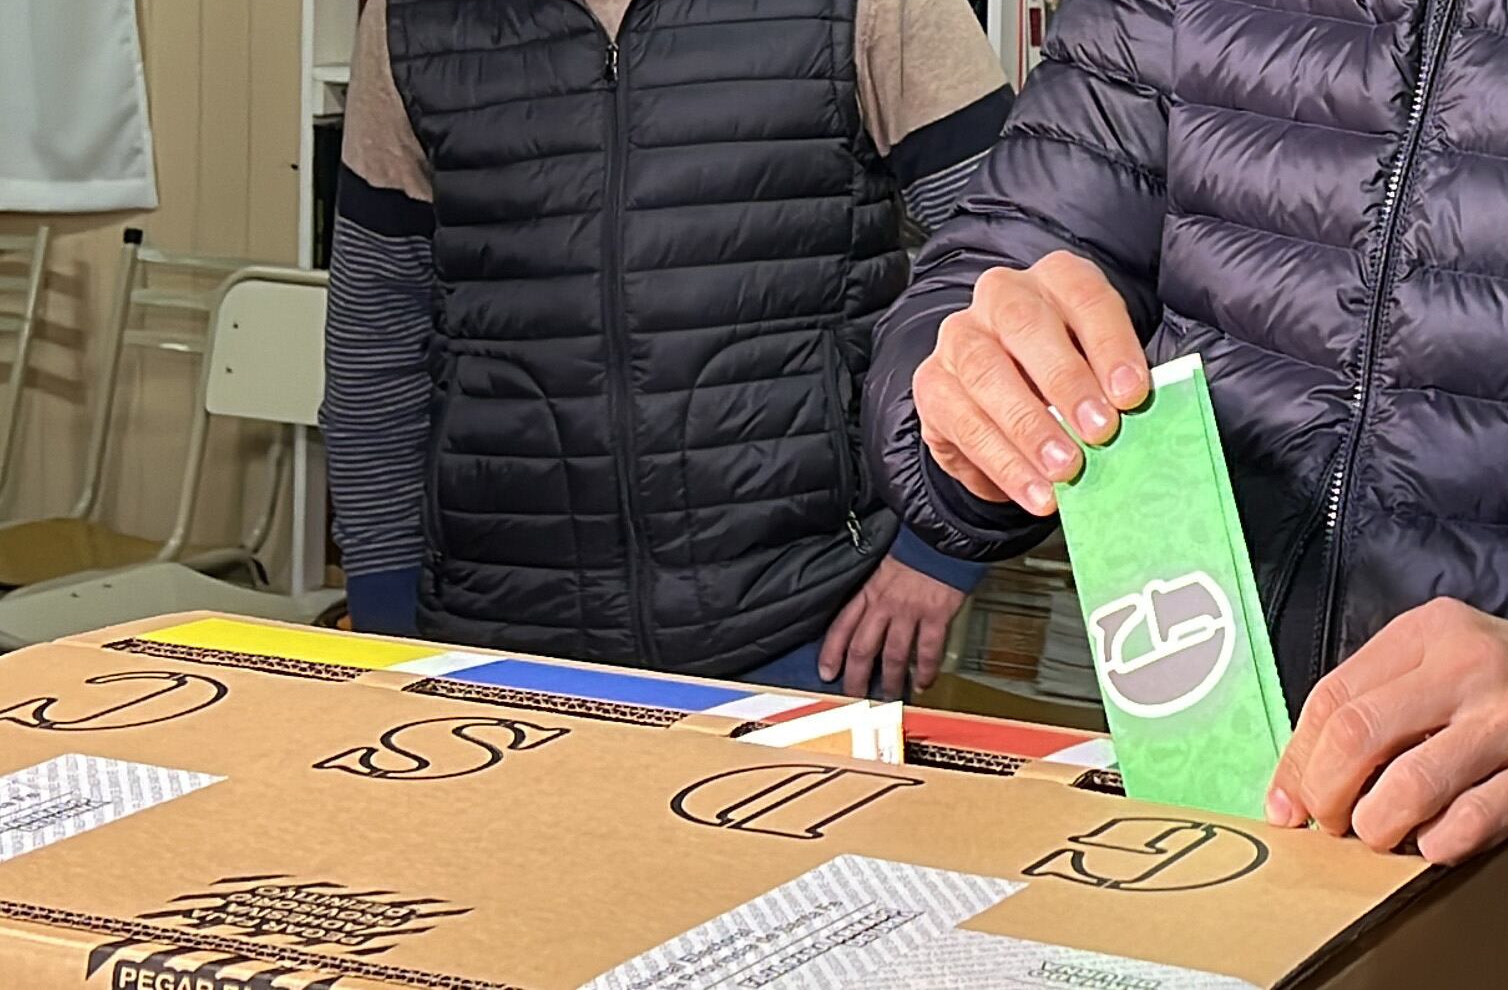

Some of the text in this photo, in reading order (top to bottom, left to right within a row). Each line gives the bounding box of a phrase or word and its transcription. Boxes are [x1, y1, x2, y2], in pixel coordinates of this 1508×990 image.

[312, 717, 571, 780] S
[670, 763, 925, 839] D
[1021, 817, 1269, 892] G
[225, 893, 403, 927] PROVISORIO
[226, 903, 367, 931] ADHESIVA
[254, 884, 411, 916] DEFINITIVO
[190, 908, 365, 945] PEGAR FAJA
